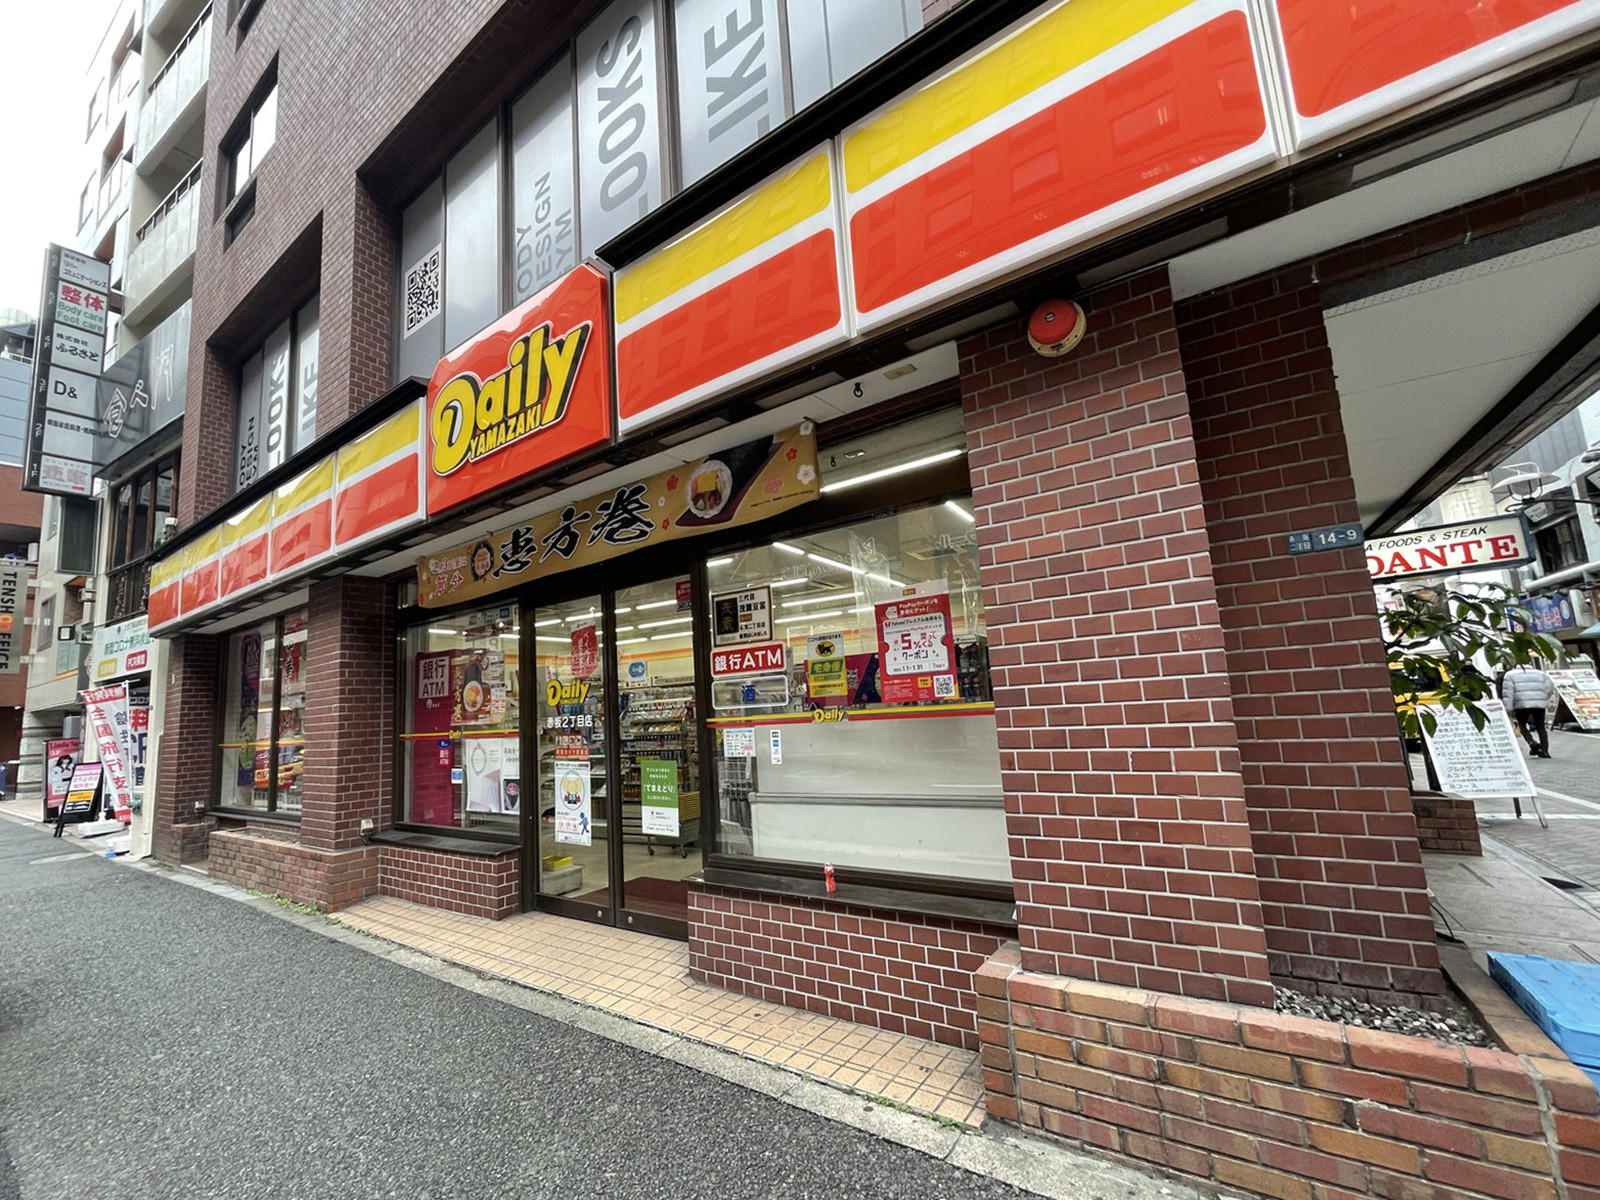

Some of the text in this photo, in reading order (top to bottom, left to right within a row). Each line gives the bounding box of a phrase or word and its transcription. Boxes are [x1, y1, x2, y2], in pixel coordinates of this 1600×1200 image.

[704, 0, 770, 142] IKE
[596, 15, 650, 215] OOKS
[534, 171, 553, 289] ESIGN
[554, 208, 573, 272] YM
[517, 224, 533, 295] ODY
[61, 284, 105, 312] 整体
[56, 311, 103, 333] Foot care
[58, 301, 104, 323] Body care
[56, 343, 99, 363] ふるさと
[53, 380, 78, 399] D&
[431, 321, 592, 474] Daily
[469, 403, 543, 461] YAMAZAKI
[1318, 529, 1358, 546] 14-9
[1379, 536, 1422, 551] FOODS
[1428, 533, 1437, 543] &
[1442, 525, 1489, 541] STEAK
[714, 647, 782, 673] 銀行ATM
[902, 650, 929, 661] クーポン
[422, 658, 446, 680] 銀行
[422, 680, 445, 698] ATM
[546, 680, 592, 707] Daily
[741, 684, 756, 703] 酒
[546, 714, 593, 729] 赤坂2丁目店
[813, 708, 845, 724] Daily
